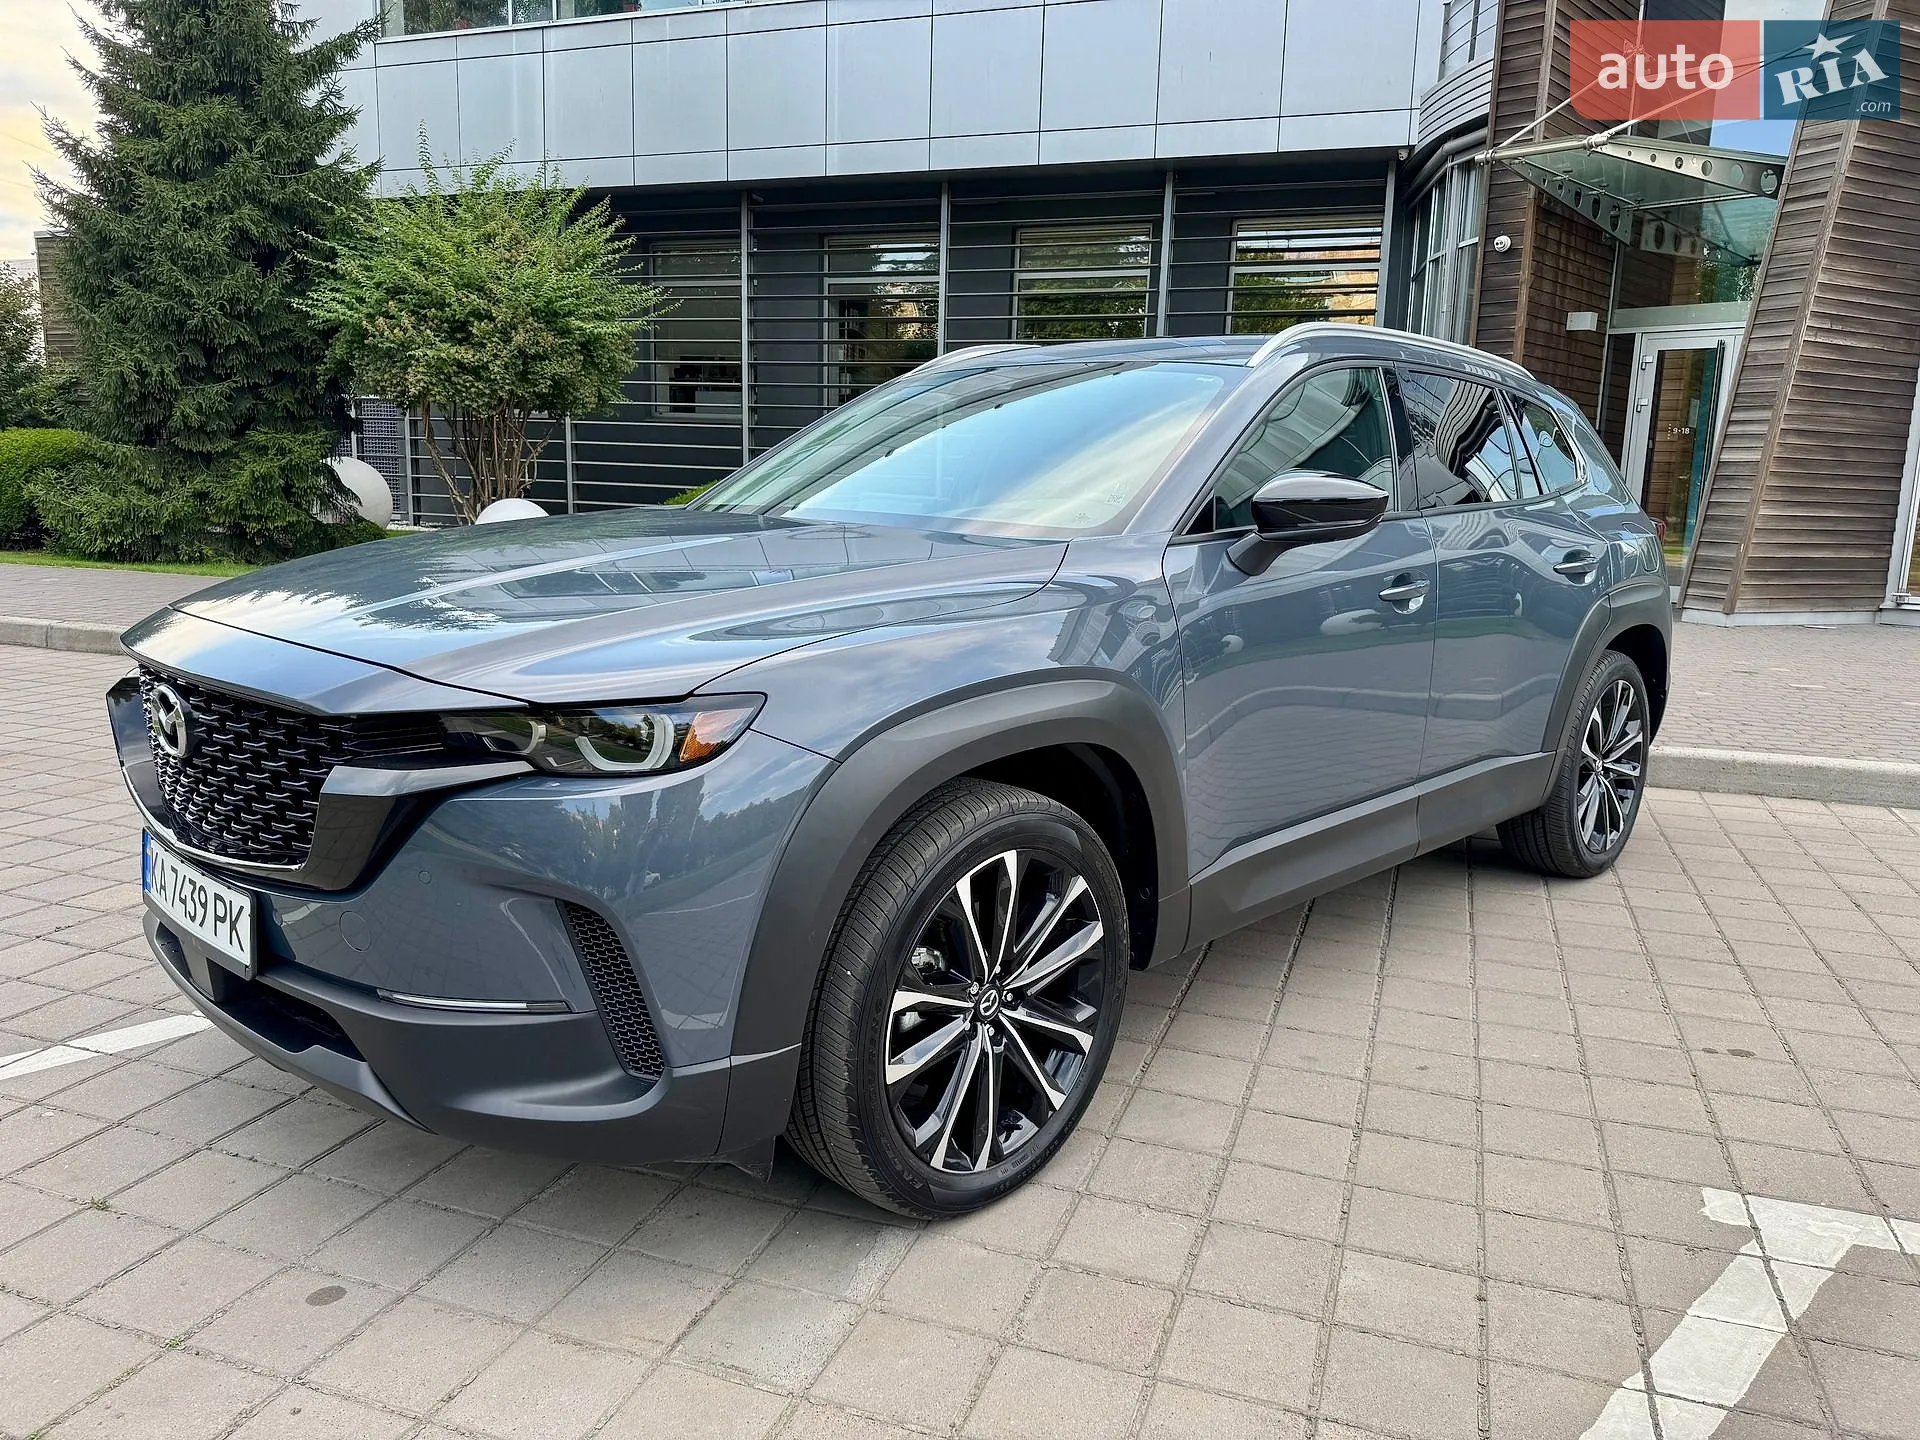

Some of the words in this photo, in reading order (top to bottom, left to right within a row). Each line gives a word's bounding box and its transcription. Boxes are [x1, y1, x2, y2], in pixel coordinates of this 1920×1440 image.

[150, 847, 168, 903] KA
[170, 864, 208, 928] 7439
[213, 892, 245, 953] PK
